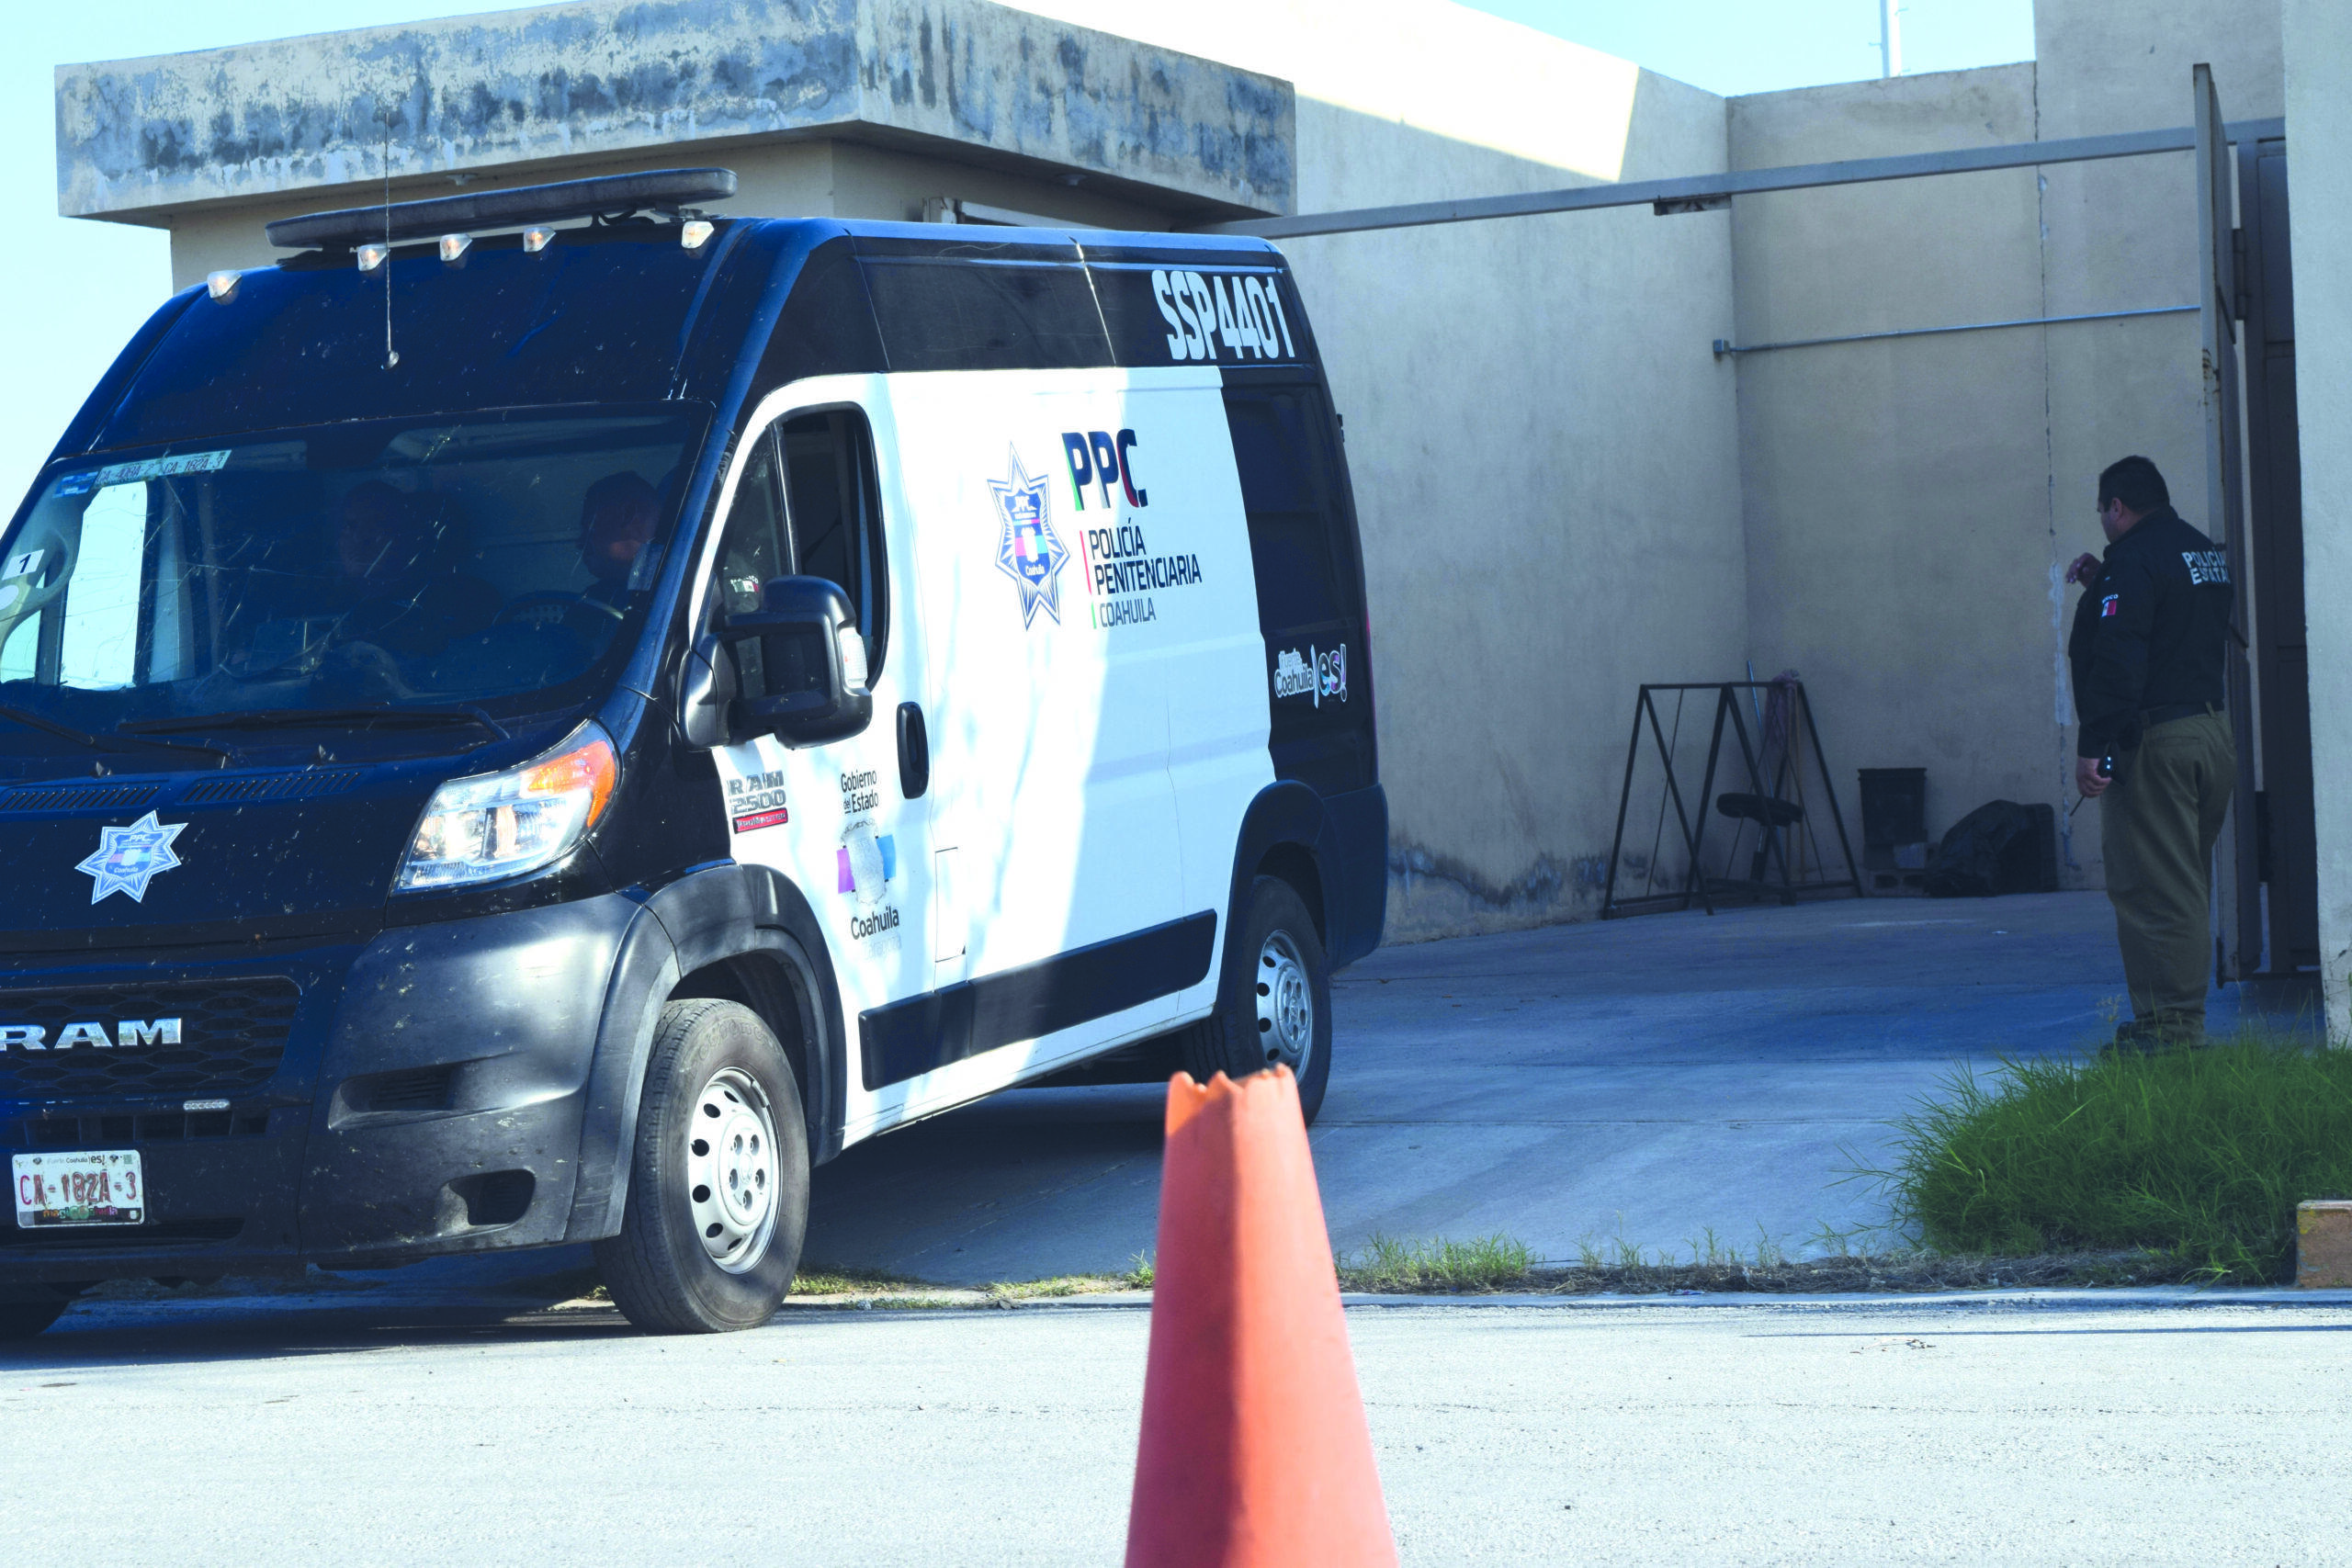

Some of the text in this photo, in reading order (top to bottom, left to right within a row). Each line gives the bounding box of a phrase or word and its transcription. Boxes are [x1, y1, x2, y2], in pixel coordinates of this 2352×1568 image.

[1152, 270, 1295, 359] SSP4401
[1061, 428, 1148, 511] PPC
[1089, 517, 1147, 560] POLICÍA
[19, 554, 31, 573] 1
[1094, 554, 1202, 595] PENITENCIARIA
[1100, 597, 1157, 628] COAHUILA
[1273, 663, 1314, 698] Coahuila
[727, 770, 785, 796] RAM
[841, 769, 877, 794] Gobierno
[729, 789, 786, 815] 2500
[843, 790, 879, 814] del Estado
[851, 905, 899, 940] Coahuila
[0, 1018, 182, 1051] RAM
